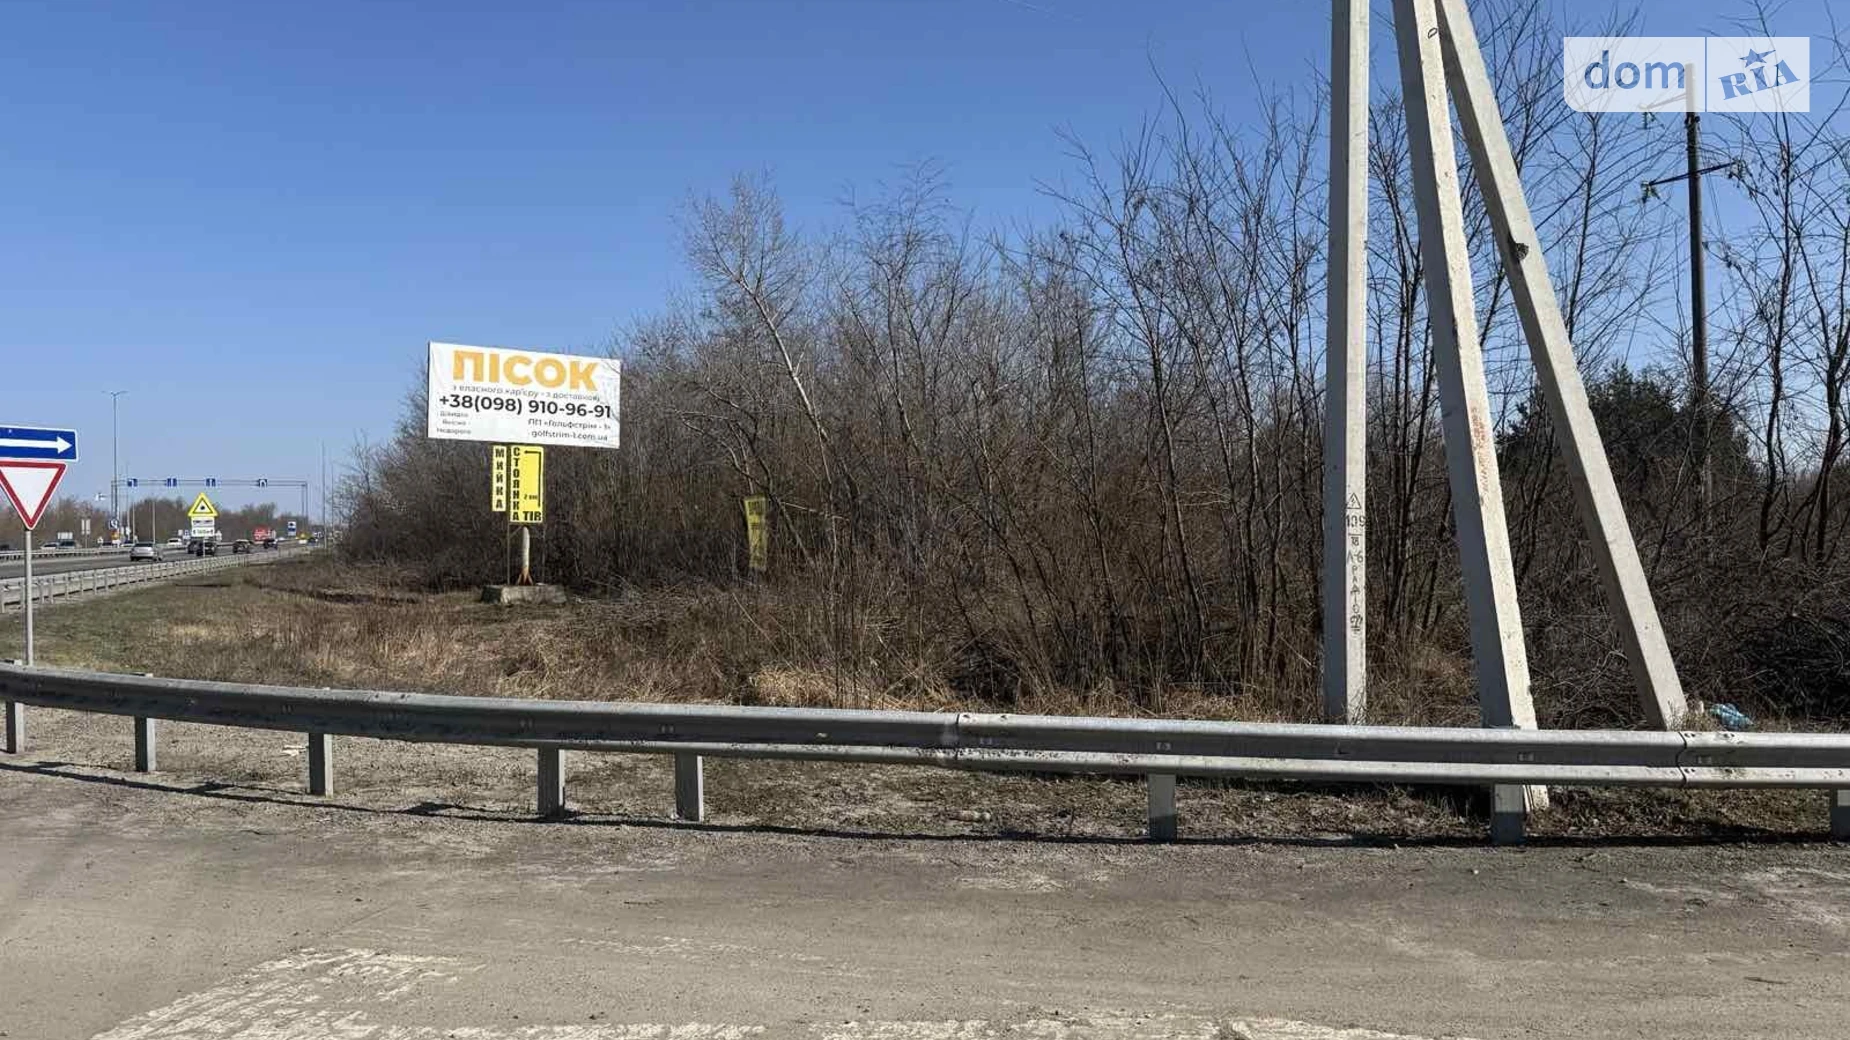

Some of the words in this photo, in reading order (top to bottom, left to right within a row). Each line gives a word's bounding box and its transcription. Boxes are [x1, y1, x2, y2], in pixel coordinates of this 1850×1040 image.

[452, 349, 598, 391] ПІСОК
[439, 394, 523, 415] +38(098)
[528, 399, 612, 418] 910-96-91
